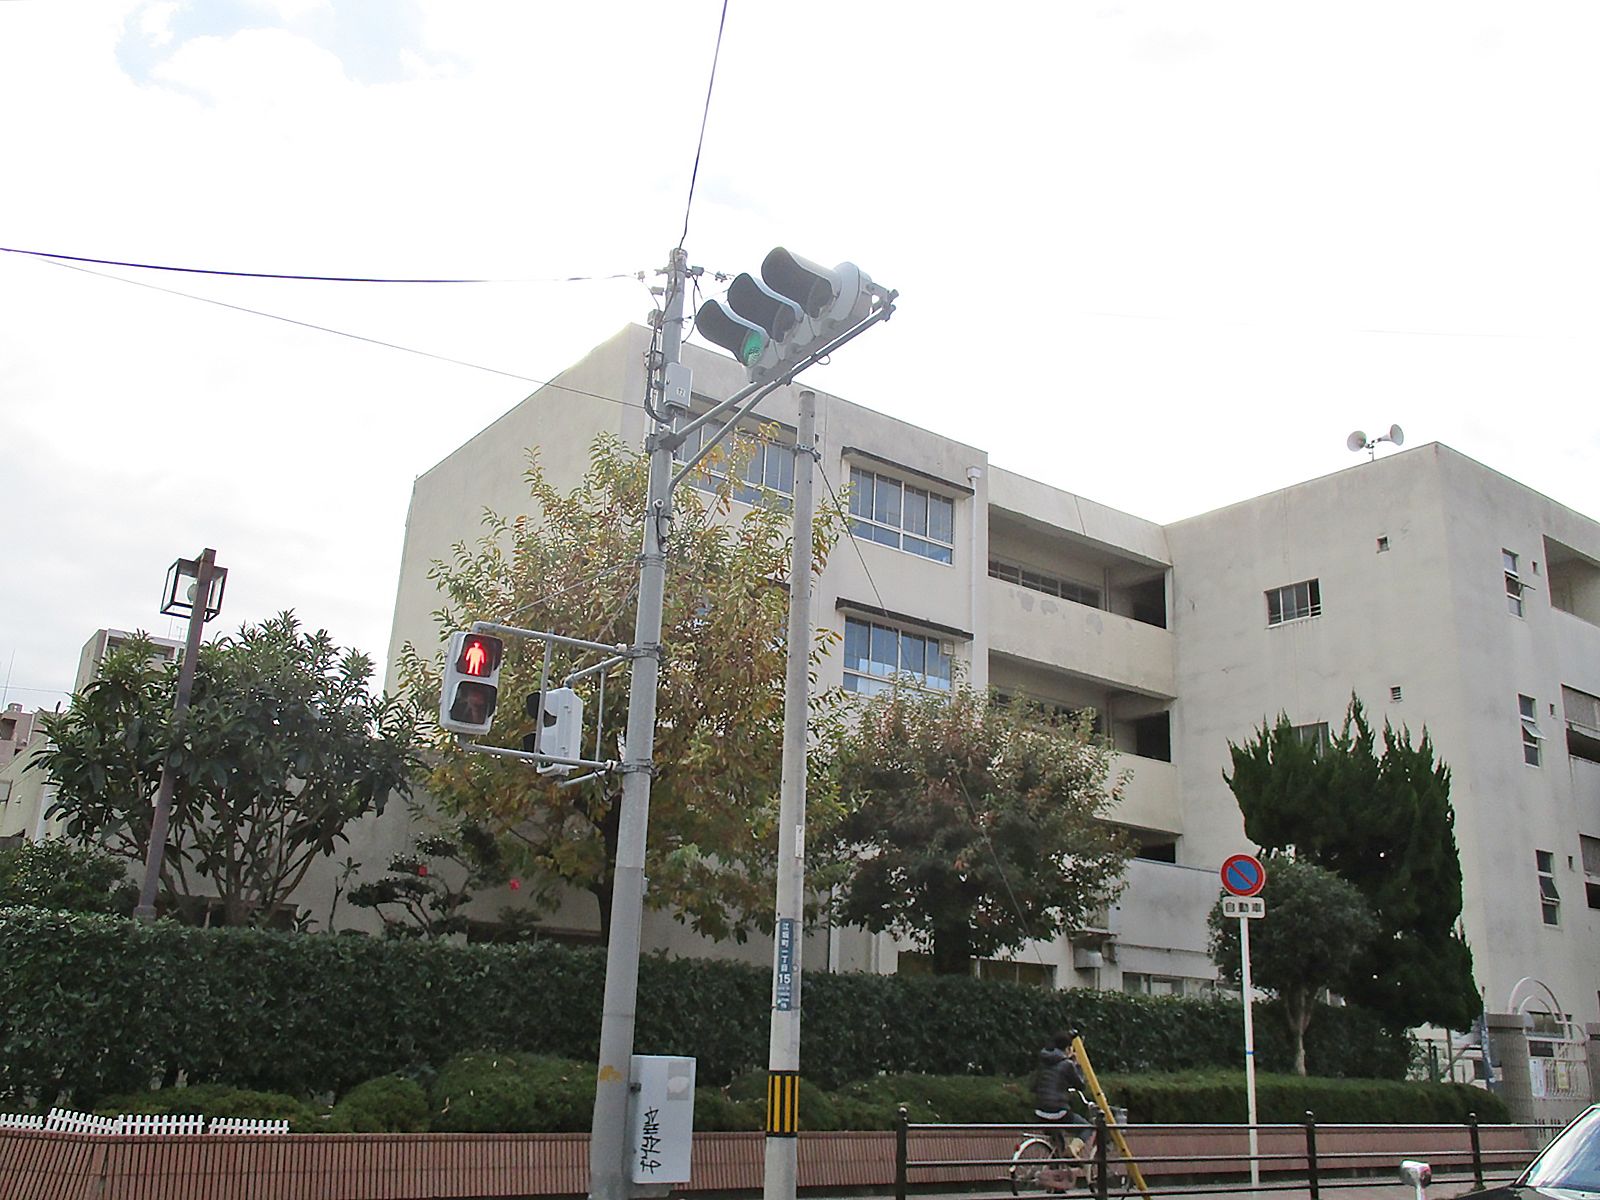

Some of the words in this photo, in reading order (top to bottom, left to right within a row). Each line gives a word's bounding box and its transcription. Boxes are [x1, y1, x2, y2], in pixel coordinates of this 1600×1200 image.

[1225, 901, 1262, 913] 自動車
[778, 973, 791, 984] 15
